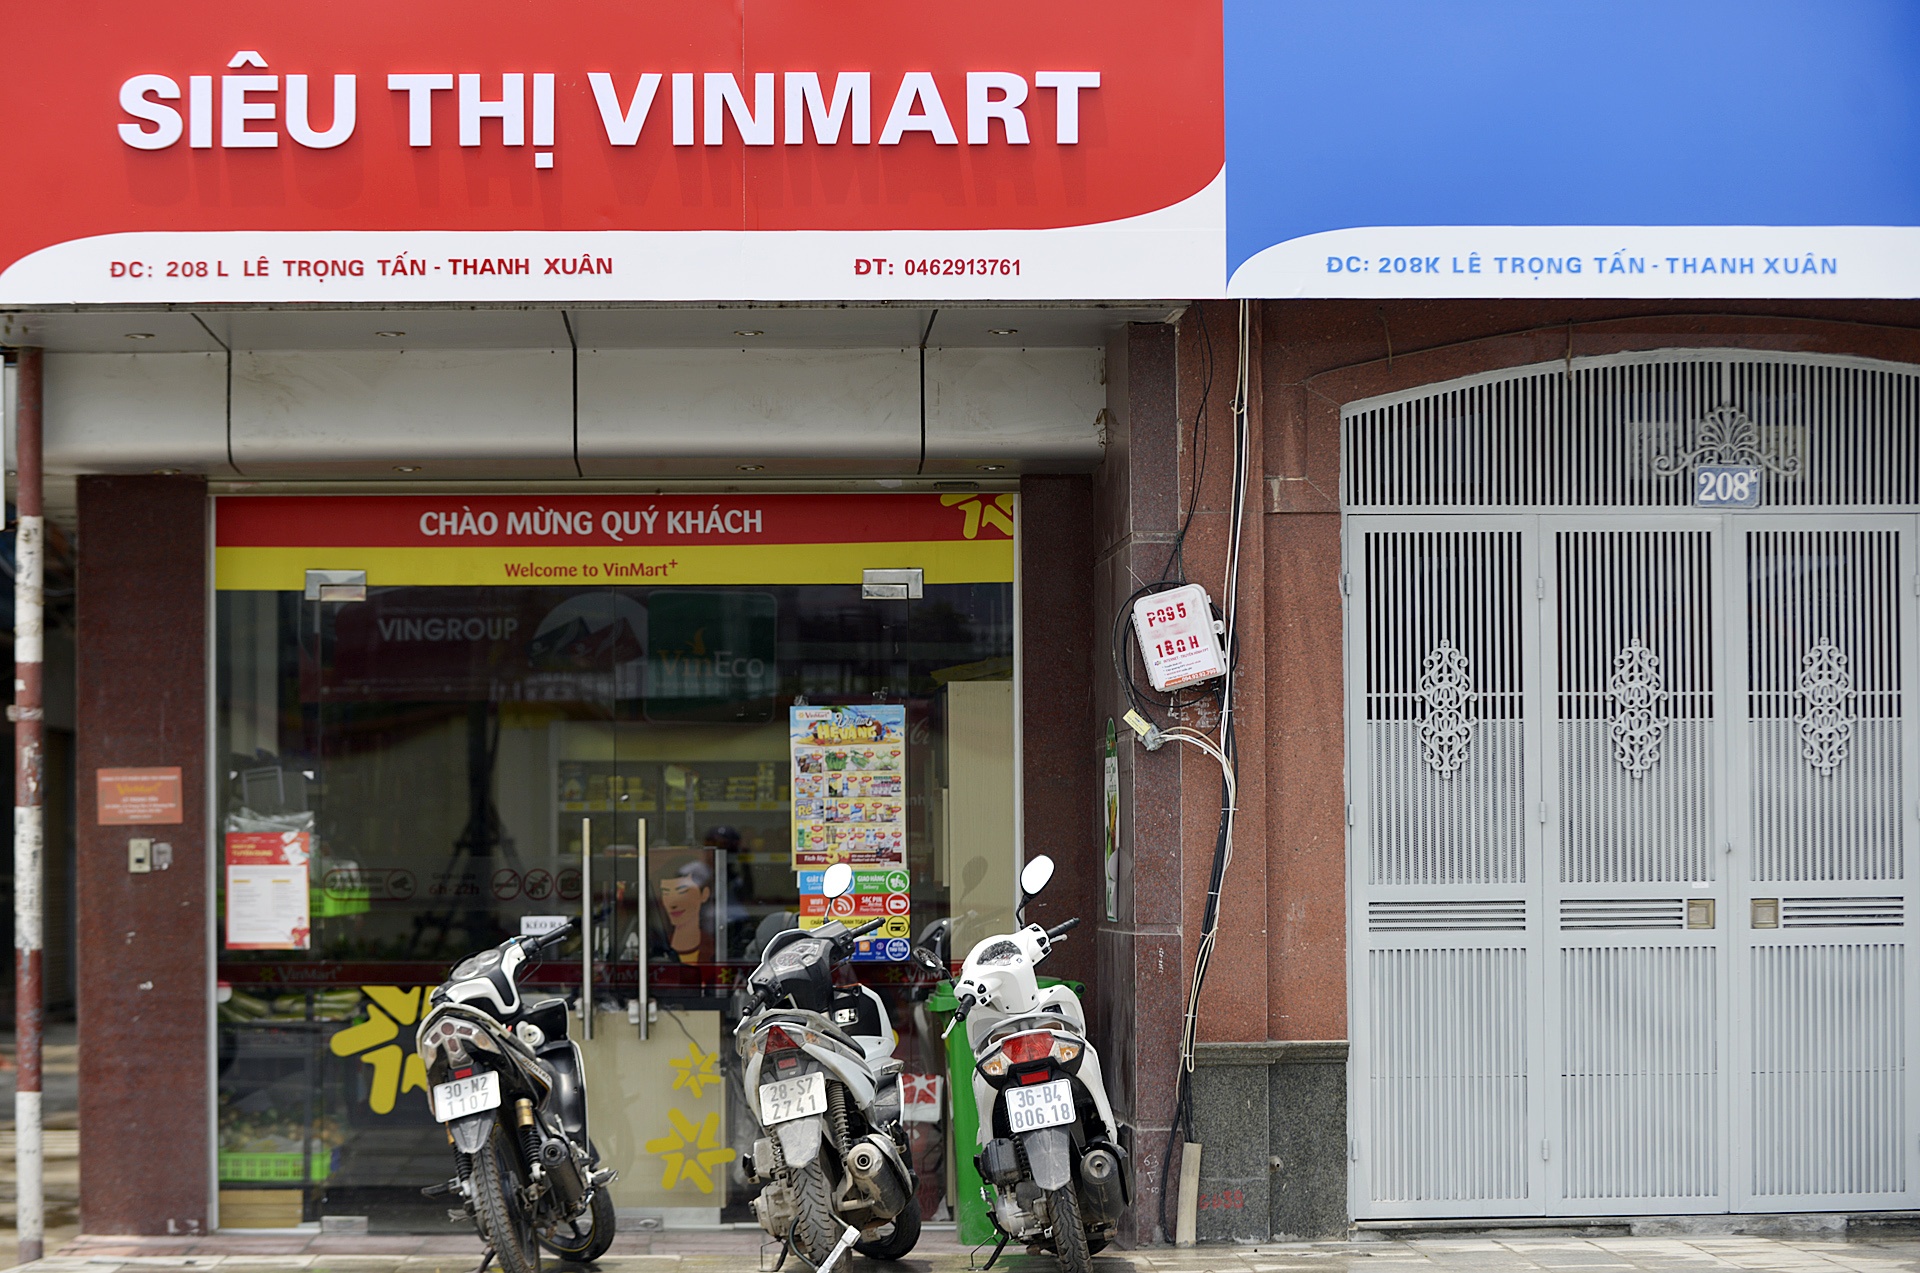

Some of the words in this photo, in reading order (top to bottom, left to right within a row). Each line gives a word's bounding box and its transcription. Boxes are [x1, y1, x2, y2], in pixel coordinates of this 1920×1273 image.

[118, 51, 356, 150] SIÊU
[388, 73, 555, 168] THỊ
[587, 71, 1101, 146] VINMART
[110, 261, 152, 278] ĐC:
[243, 255, 269, 277] LÊ
[282, 259, 365, 283] TRỌNG
[377, 252, 427, 277] TẤN
[447, 257, 530, 275] THANH
[543, 253, 613, 275] XUÂN
[853, 258, 894, 276] ĐT:
[904, 258, 1020, 276] 0462913761
[1326, 256, 1370, 274] ĐC:
[1378, 256, 1441, 274] 208K
[1452, 251, 1482, 274] LÊ
[1493, 256, 1583, 281] TRỌNG
[1593, 248, 1646, 274] TẤN
[1664, 256, 1755, 275] THANH
[1763, 252, 1838, 275] XUÂN
[420, 506, 499, 536] CHÀO
[506, 506, 593, 536] MỪNG
[601, 505, 659, 541] QUÝ
[667, 505, 762, 534] KHÁCH
[504, 562, 578, 578] Welcome
[582, 563, 598, 578] to
[377, 617, 519, 642] VINGROUP
[656, 648, 765, 679] VinEco
[444, 1076, 489, 1100] 30-N2
[770, 1077, 813, 1102] 28-S7
[1016, 1084, 1062, 1108] 36-B4
[447, 1092, 489, 1116] 1107
[772, 1094, 816, 1120] 2741
[1014, 1103, 1071, 1129] 806.18
